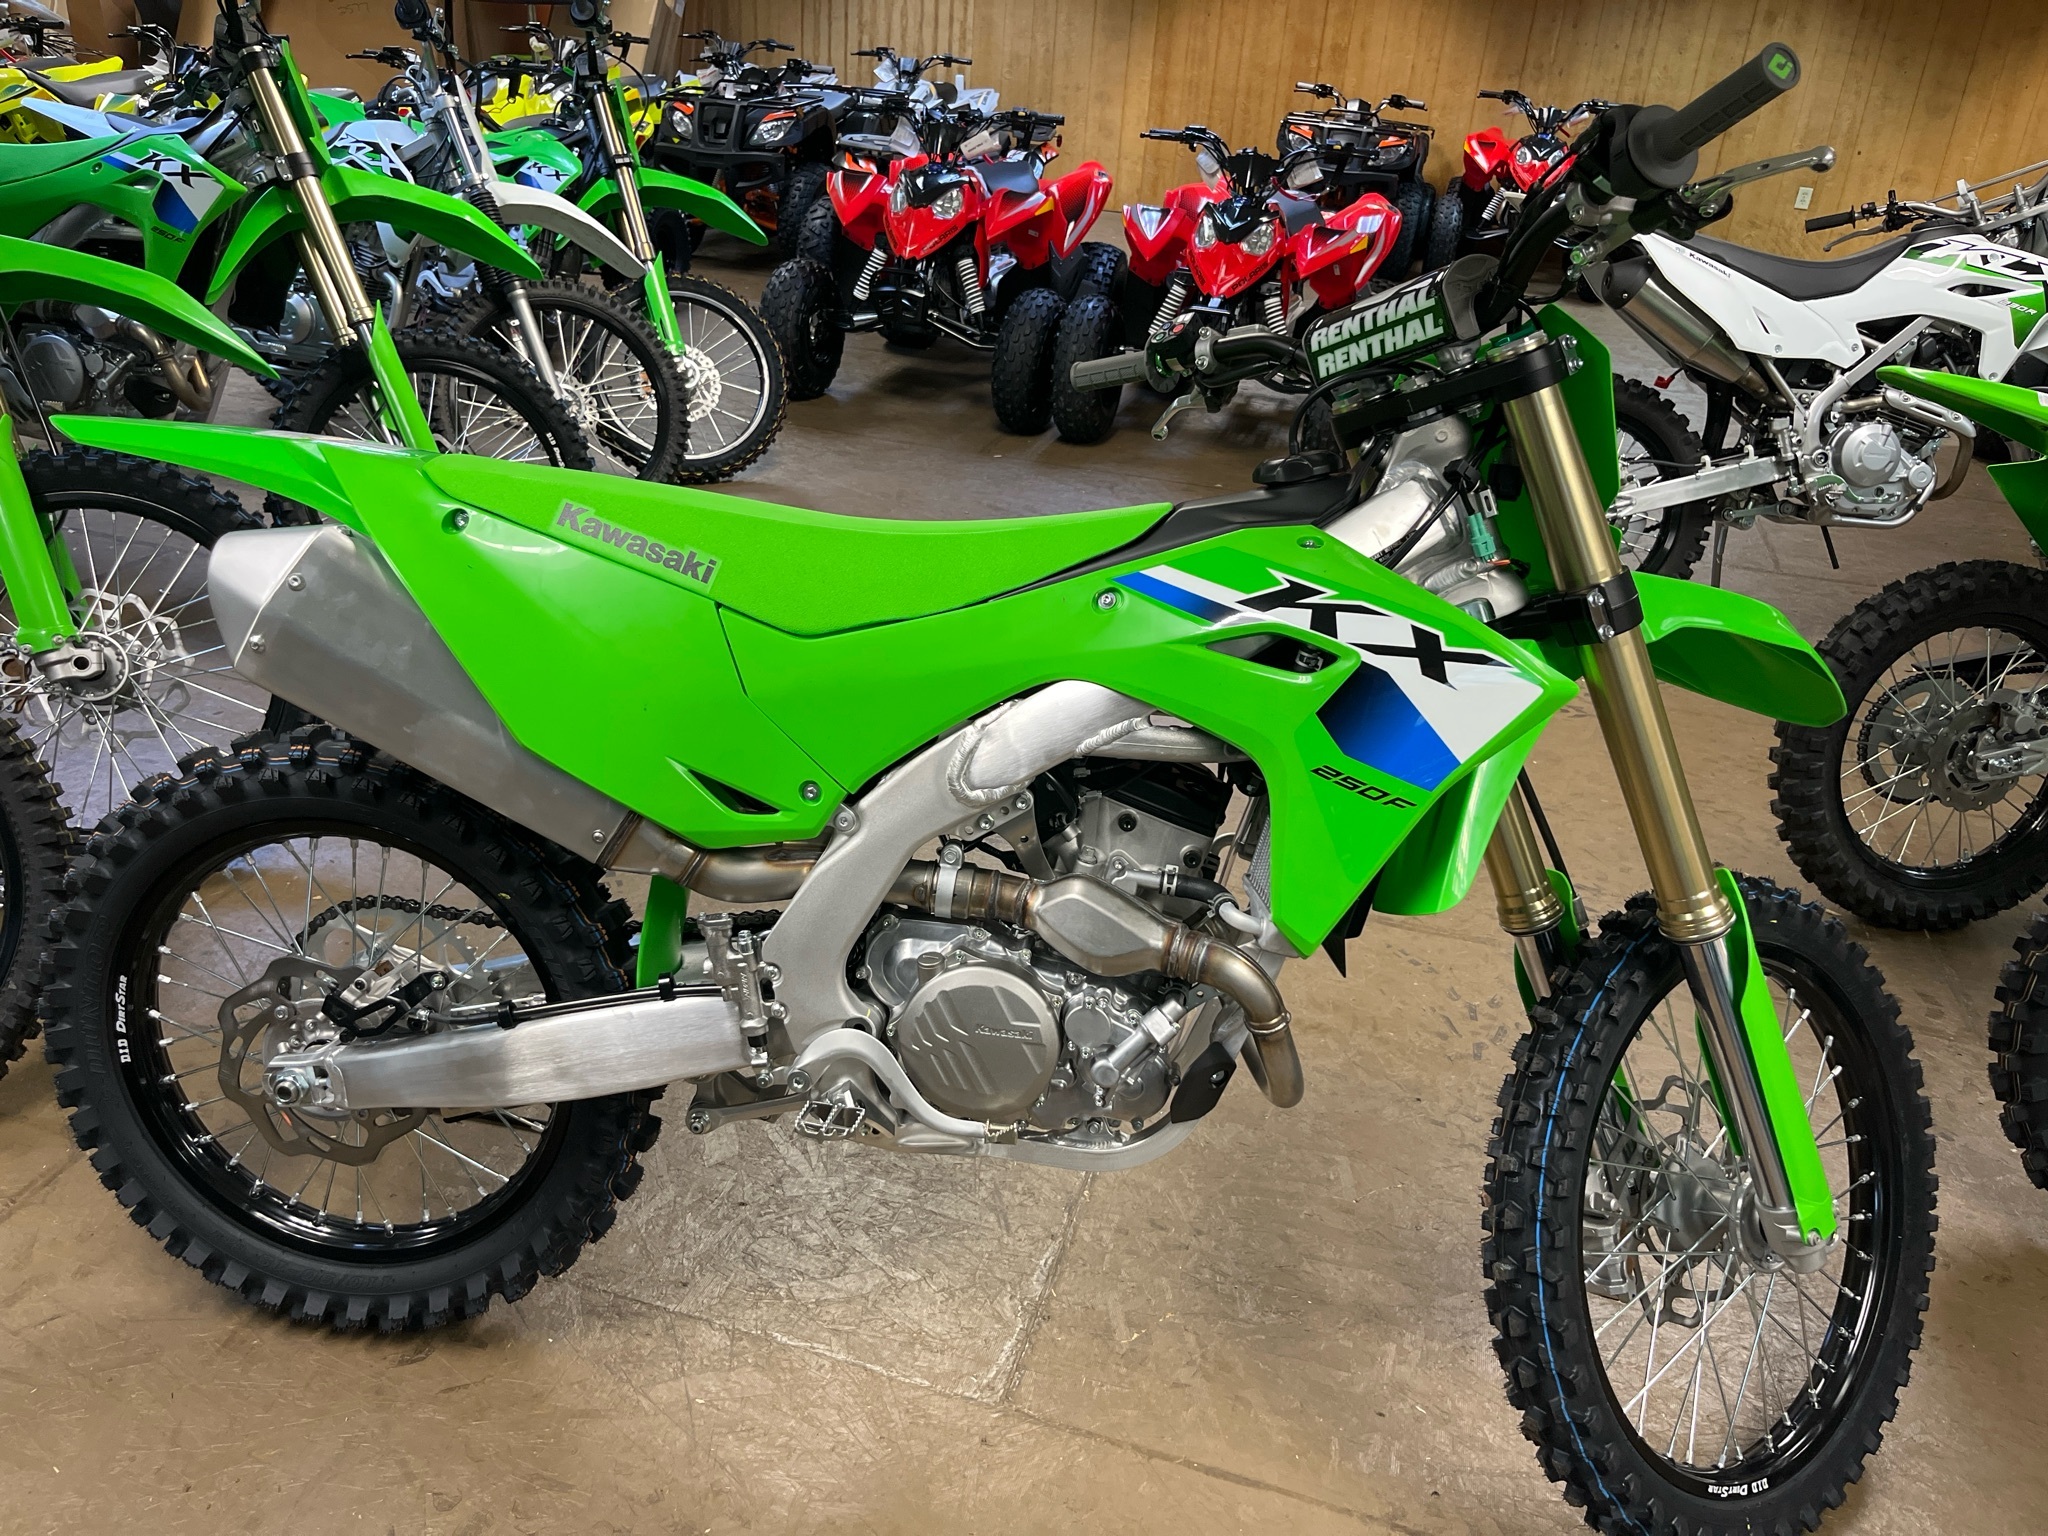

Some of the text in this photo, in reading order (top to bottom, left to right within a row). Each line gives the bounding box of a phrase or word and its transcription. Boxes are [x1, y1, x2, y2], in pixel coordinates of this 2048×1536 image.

[136, 150, 214, 190] KX
[526, 161, 571, 182] KX
[151, 226, 187, 244] 250F
[1231, 262, 1269, 291] POLARIS
[1689, 252, 1731, 278] Kawasaki
[1310, 285, 1436, 353] RENTHAL
[1317, 312, 1444, 379] RENTHAL
[557, 502, 718, 584] Kawasaki
[1235, 576, 1516, 690] KX
[1309, 765, 1418, 811] 250F
[975, 1024, 1034, 1040] Kawasaki
[118, 1038, 131, 1063] DID
[1751, 1477, 1769, 1494] DID
